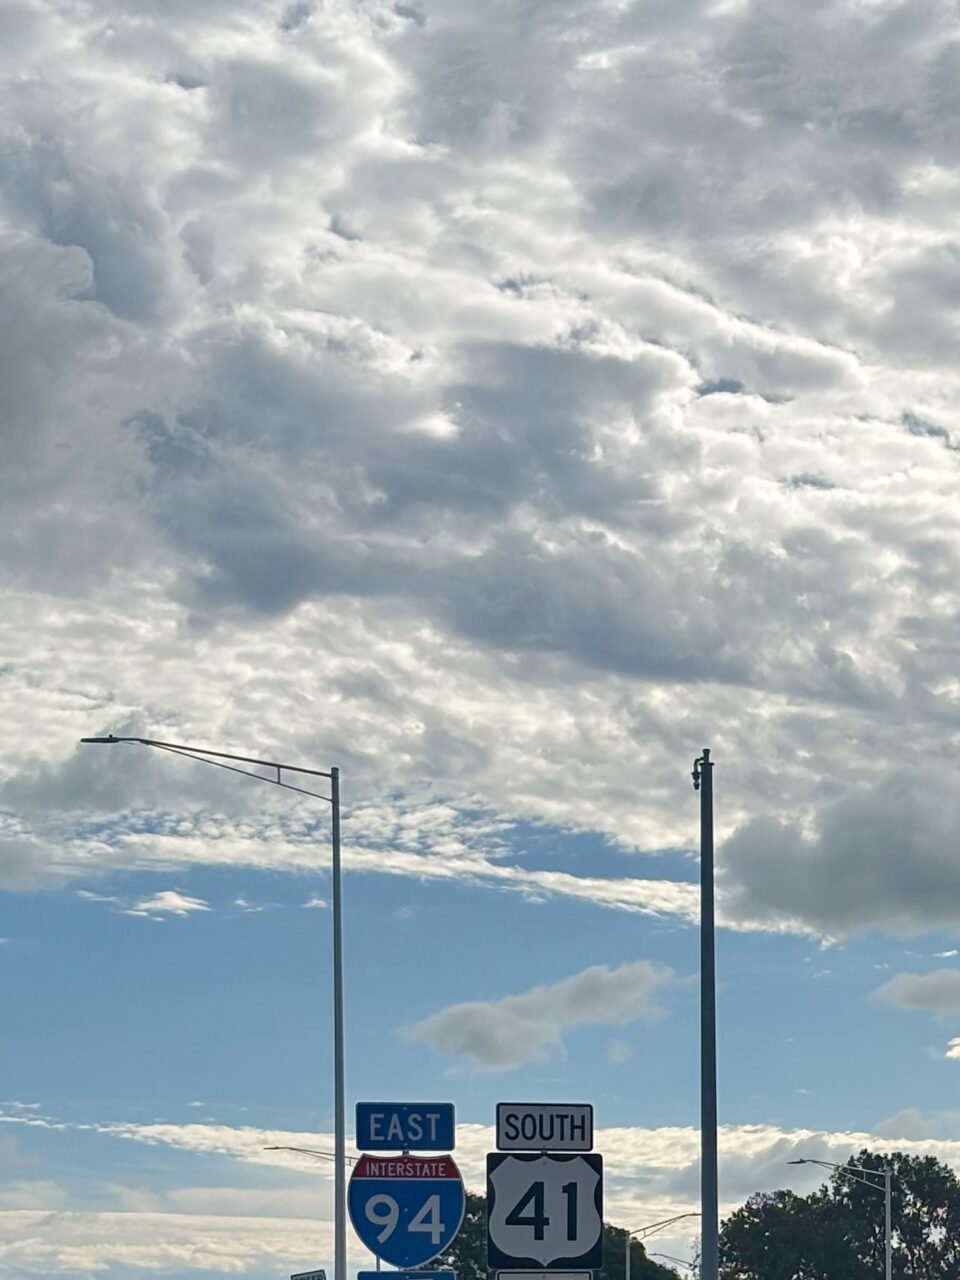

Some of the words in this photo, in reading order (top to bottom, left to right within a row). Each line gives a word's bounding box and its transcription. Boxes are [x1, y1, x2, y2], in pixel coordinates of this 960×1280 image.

[369, 1113, 441, 1141] EAST
[504, 1113, 586, 1141] SOUTH
[366, 1162, 446, 1177] INTERSTATE
[365, 1193, 445, 1244] 94
[505, 1181, 578, 1241] 41
